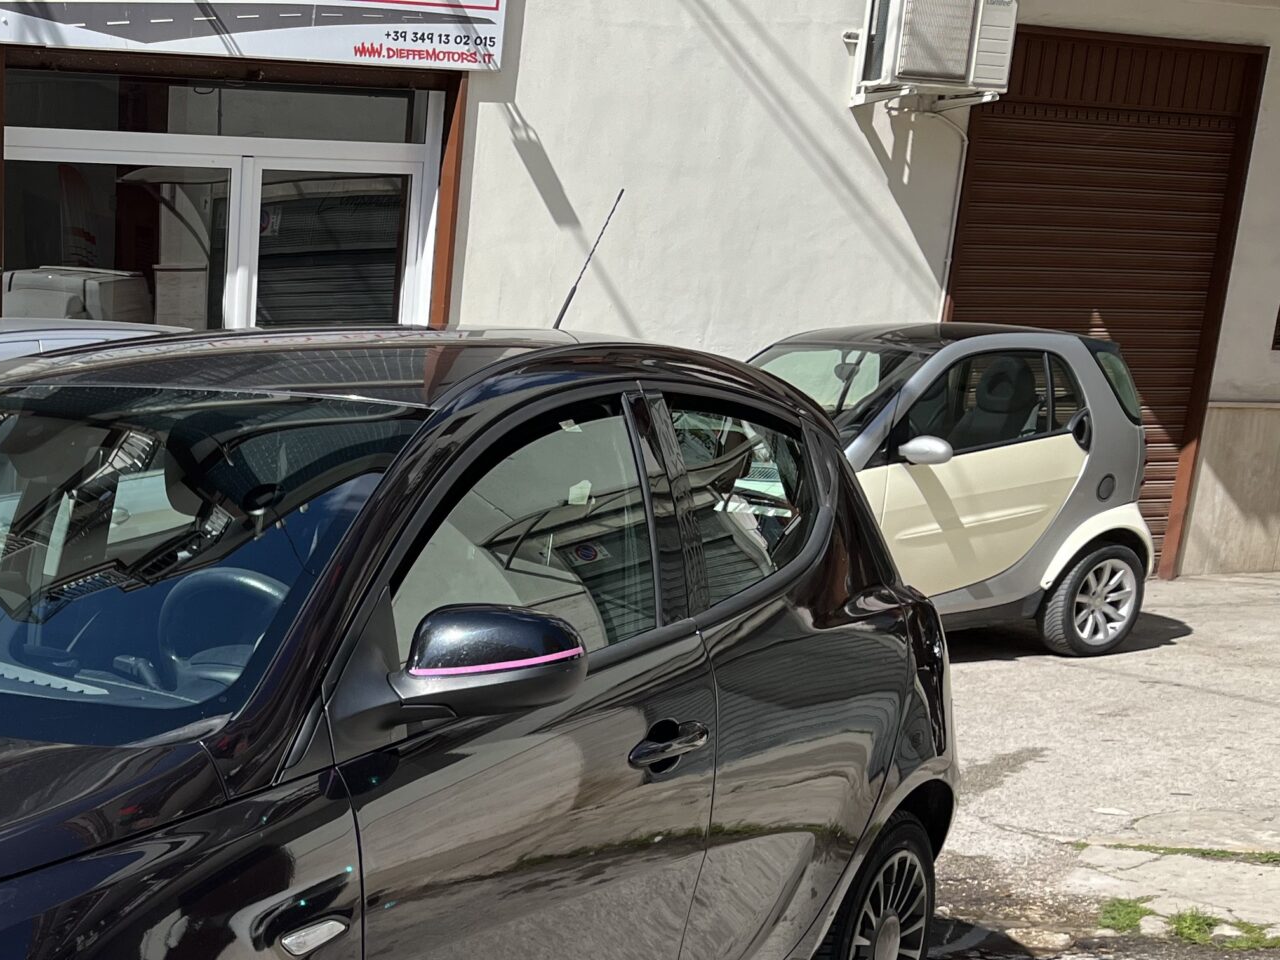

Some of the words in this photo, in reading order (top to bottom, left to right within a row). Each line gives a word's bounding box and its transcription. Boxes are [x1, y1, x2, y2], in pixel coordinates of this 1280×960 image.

[385, 31, 407, 42] +39
[411, 32, 434, 44] 349
[438, 34, 450, 45] 13
[454, 35, 470, 46] 02
[474, 36, 496, 48] 015
